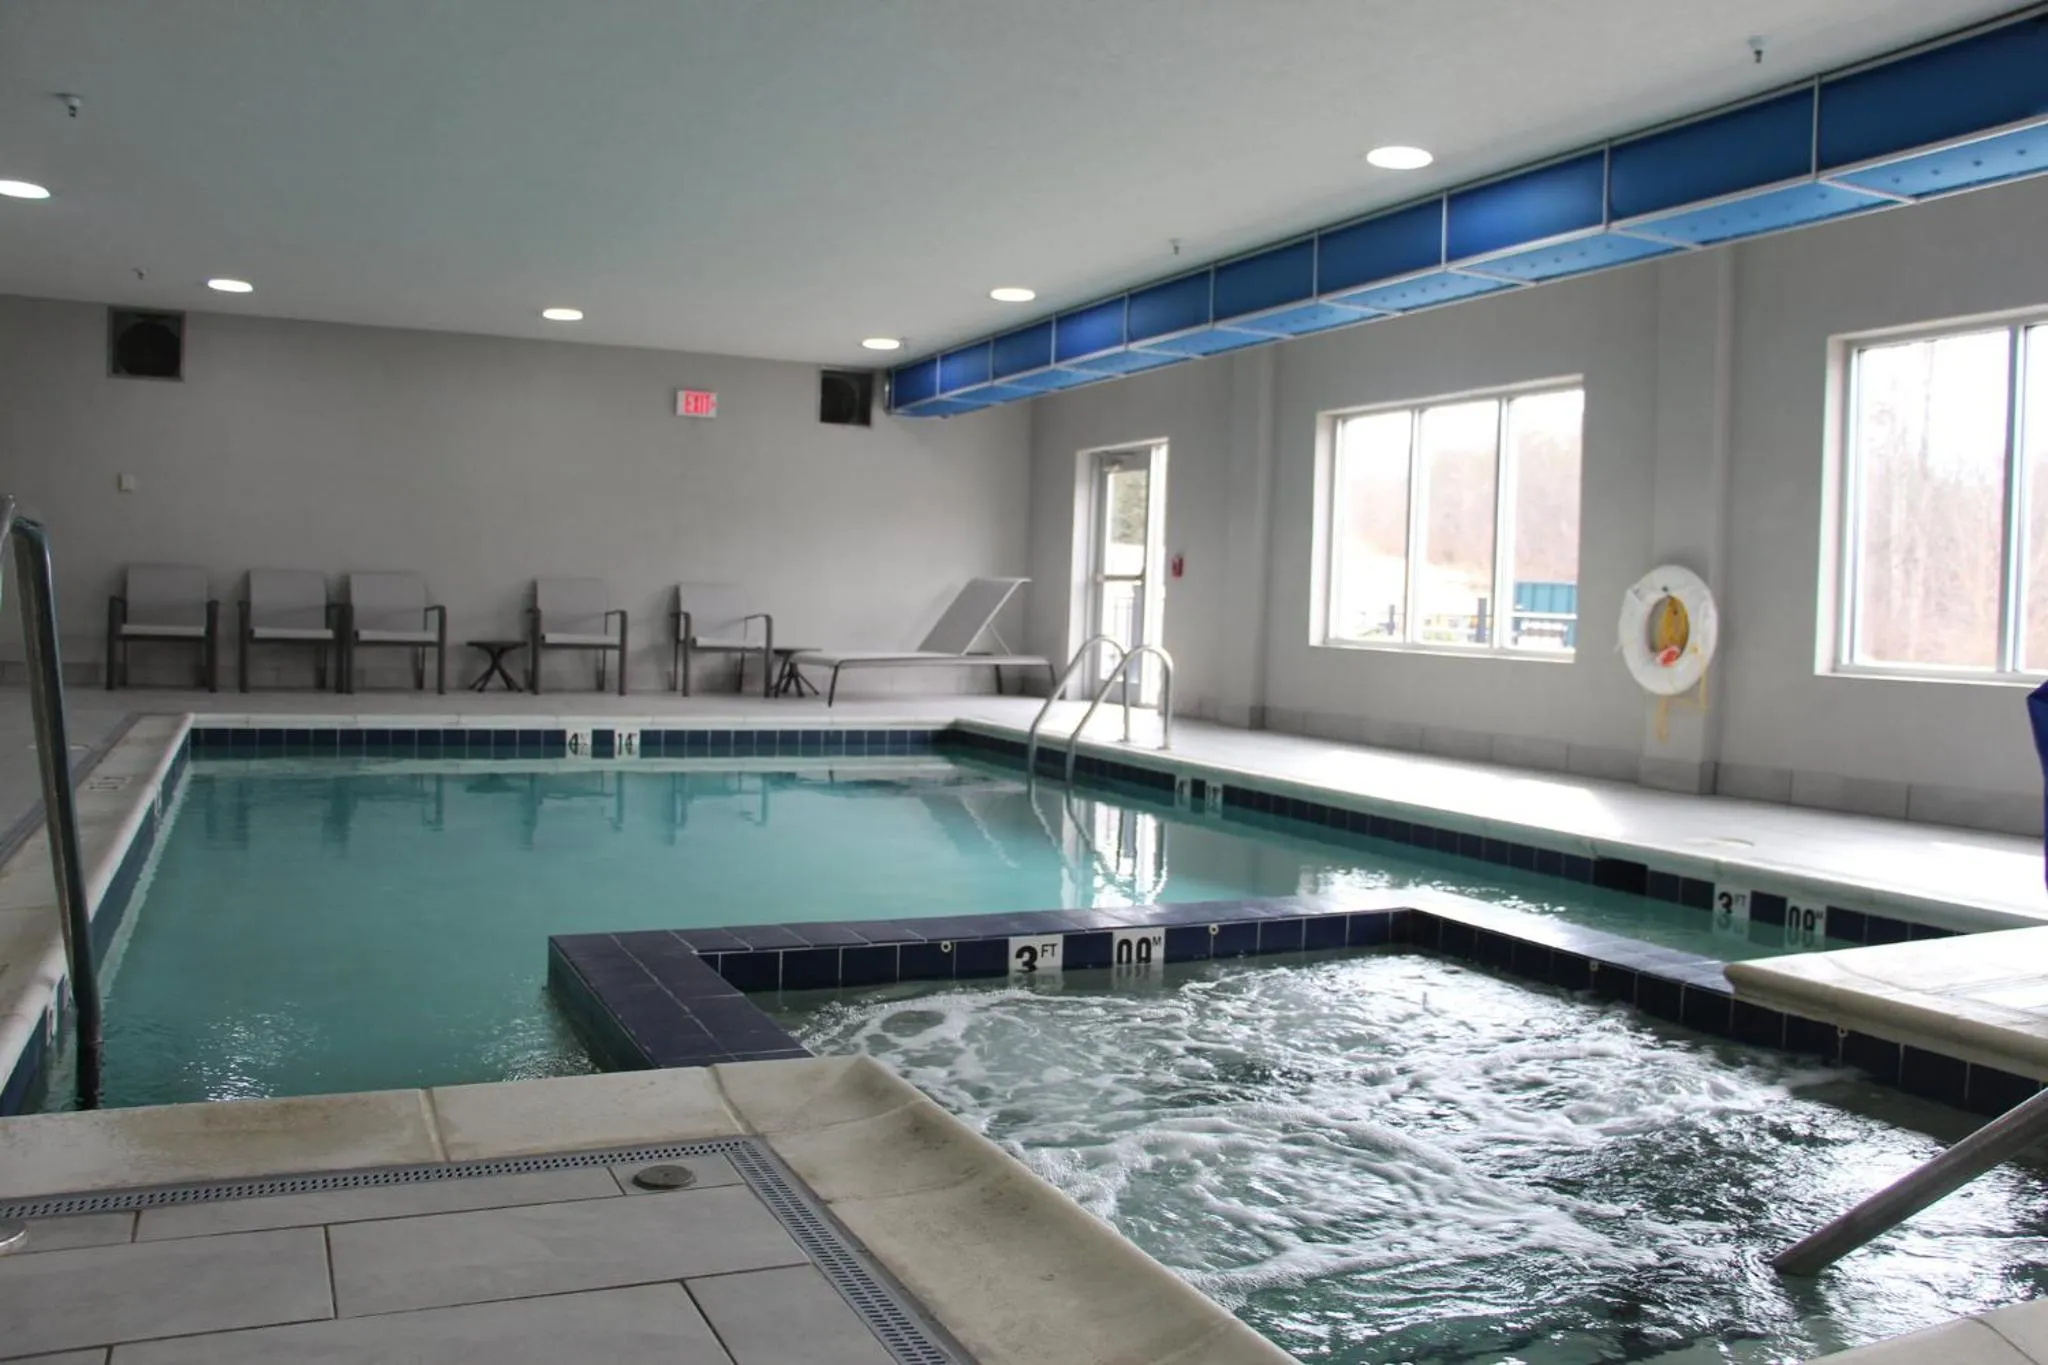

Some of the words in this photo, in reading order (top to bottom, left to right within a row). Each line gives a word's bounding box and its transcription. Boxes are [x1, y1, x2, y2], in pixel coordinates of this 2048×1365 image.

[684, 392, 711, 415] EXIT
[1015, 945, 1038, 972] 3
[1041, 943, 1058, 959] FT
